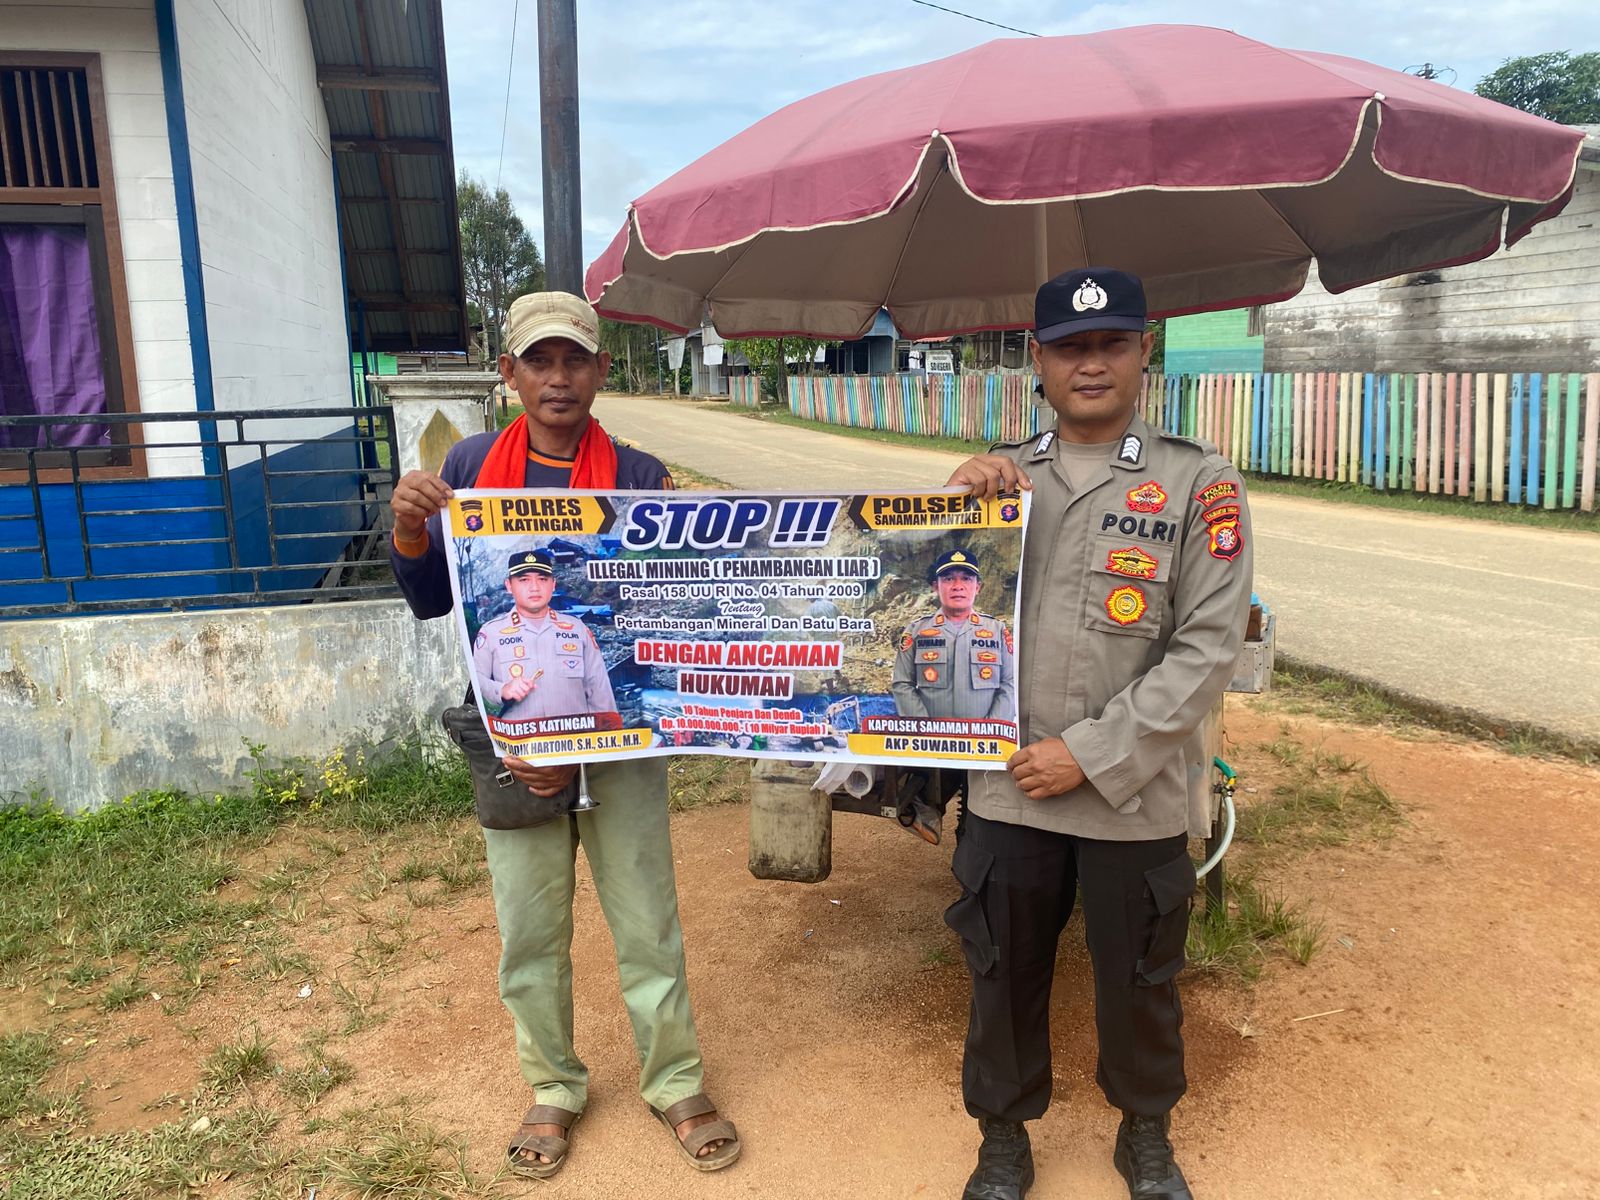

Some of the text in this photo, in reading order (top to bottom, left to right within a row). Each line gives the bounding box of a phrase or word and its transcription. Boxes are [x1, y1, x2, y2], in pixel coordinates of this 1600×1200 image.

[501, 499, 581, 516] POLRES
[873, 496, 982, 514] POLSEK
[504, 518, 583, 532] KATINGAN
[626, 501, 838, 546] STOP !!!
[875, 511, 982, 526] SANAMAN MANTIKEI
[1102, 513, 1176, 542] POLRI
[589, 561, 642, 579] ILLEGAL
[645, 560, 710, 578] MINNING
[723, 559, 833, 578] PENAMBANGAN
[837, 559, 869, 577] LIAR
[622, 585, 861, 598] Pasal 158 UU RI No. 04 Tahun 2009
[720, 601, 763, 615] Tentang
[617, 618, 872, 631] Pertambangan Mineral Dan Batu Bara
[500, 636, 523, 646] DODIK
[556, 632, 579, 640] POLRI
[971, 639, 1000, 649] POLRI
[638, 641, 841, 667] DENGAN ANCAMAN
[681, 673, 790, 697] HUKUMAN
[683, 705, 801, 720] 10 Tahun Penjara Dan Denda
[492, 716, 595, 736] KAPOLRES KATINGAN
[661, 719, 675, 730] Rp.
[751, 724, 760, 734] 10
[761, 724, 788, 735] Milyar
[790, 725, 820, 735] Rupiah
[868, 720, 1016, 739] KAPOLSEK SANAMAN MANTIKEI
[531, 739, 576, 754] HARTONO,
[577, 737, 596, 750] S.H.,
[598, 735, 621, 749] S.I.K.,
[623, 734, 641, 747] M.H.
[885, 737, 1001, 754] AKP SUWARDI, S.H.
